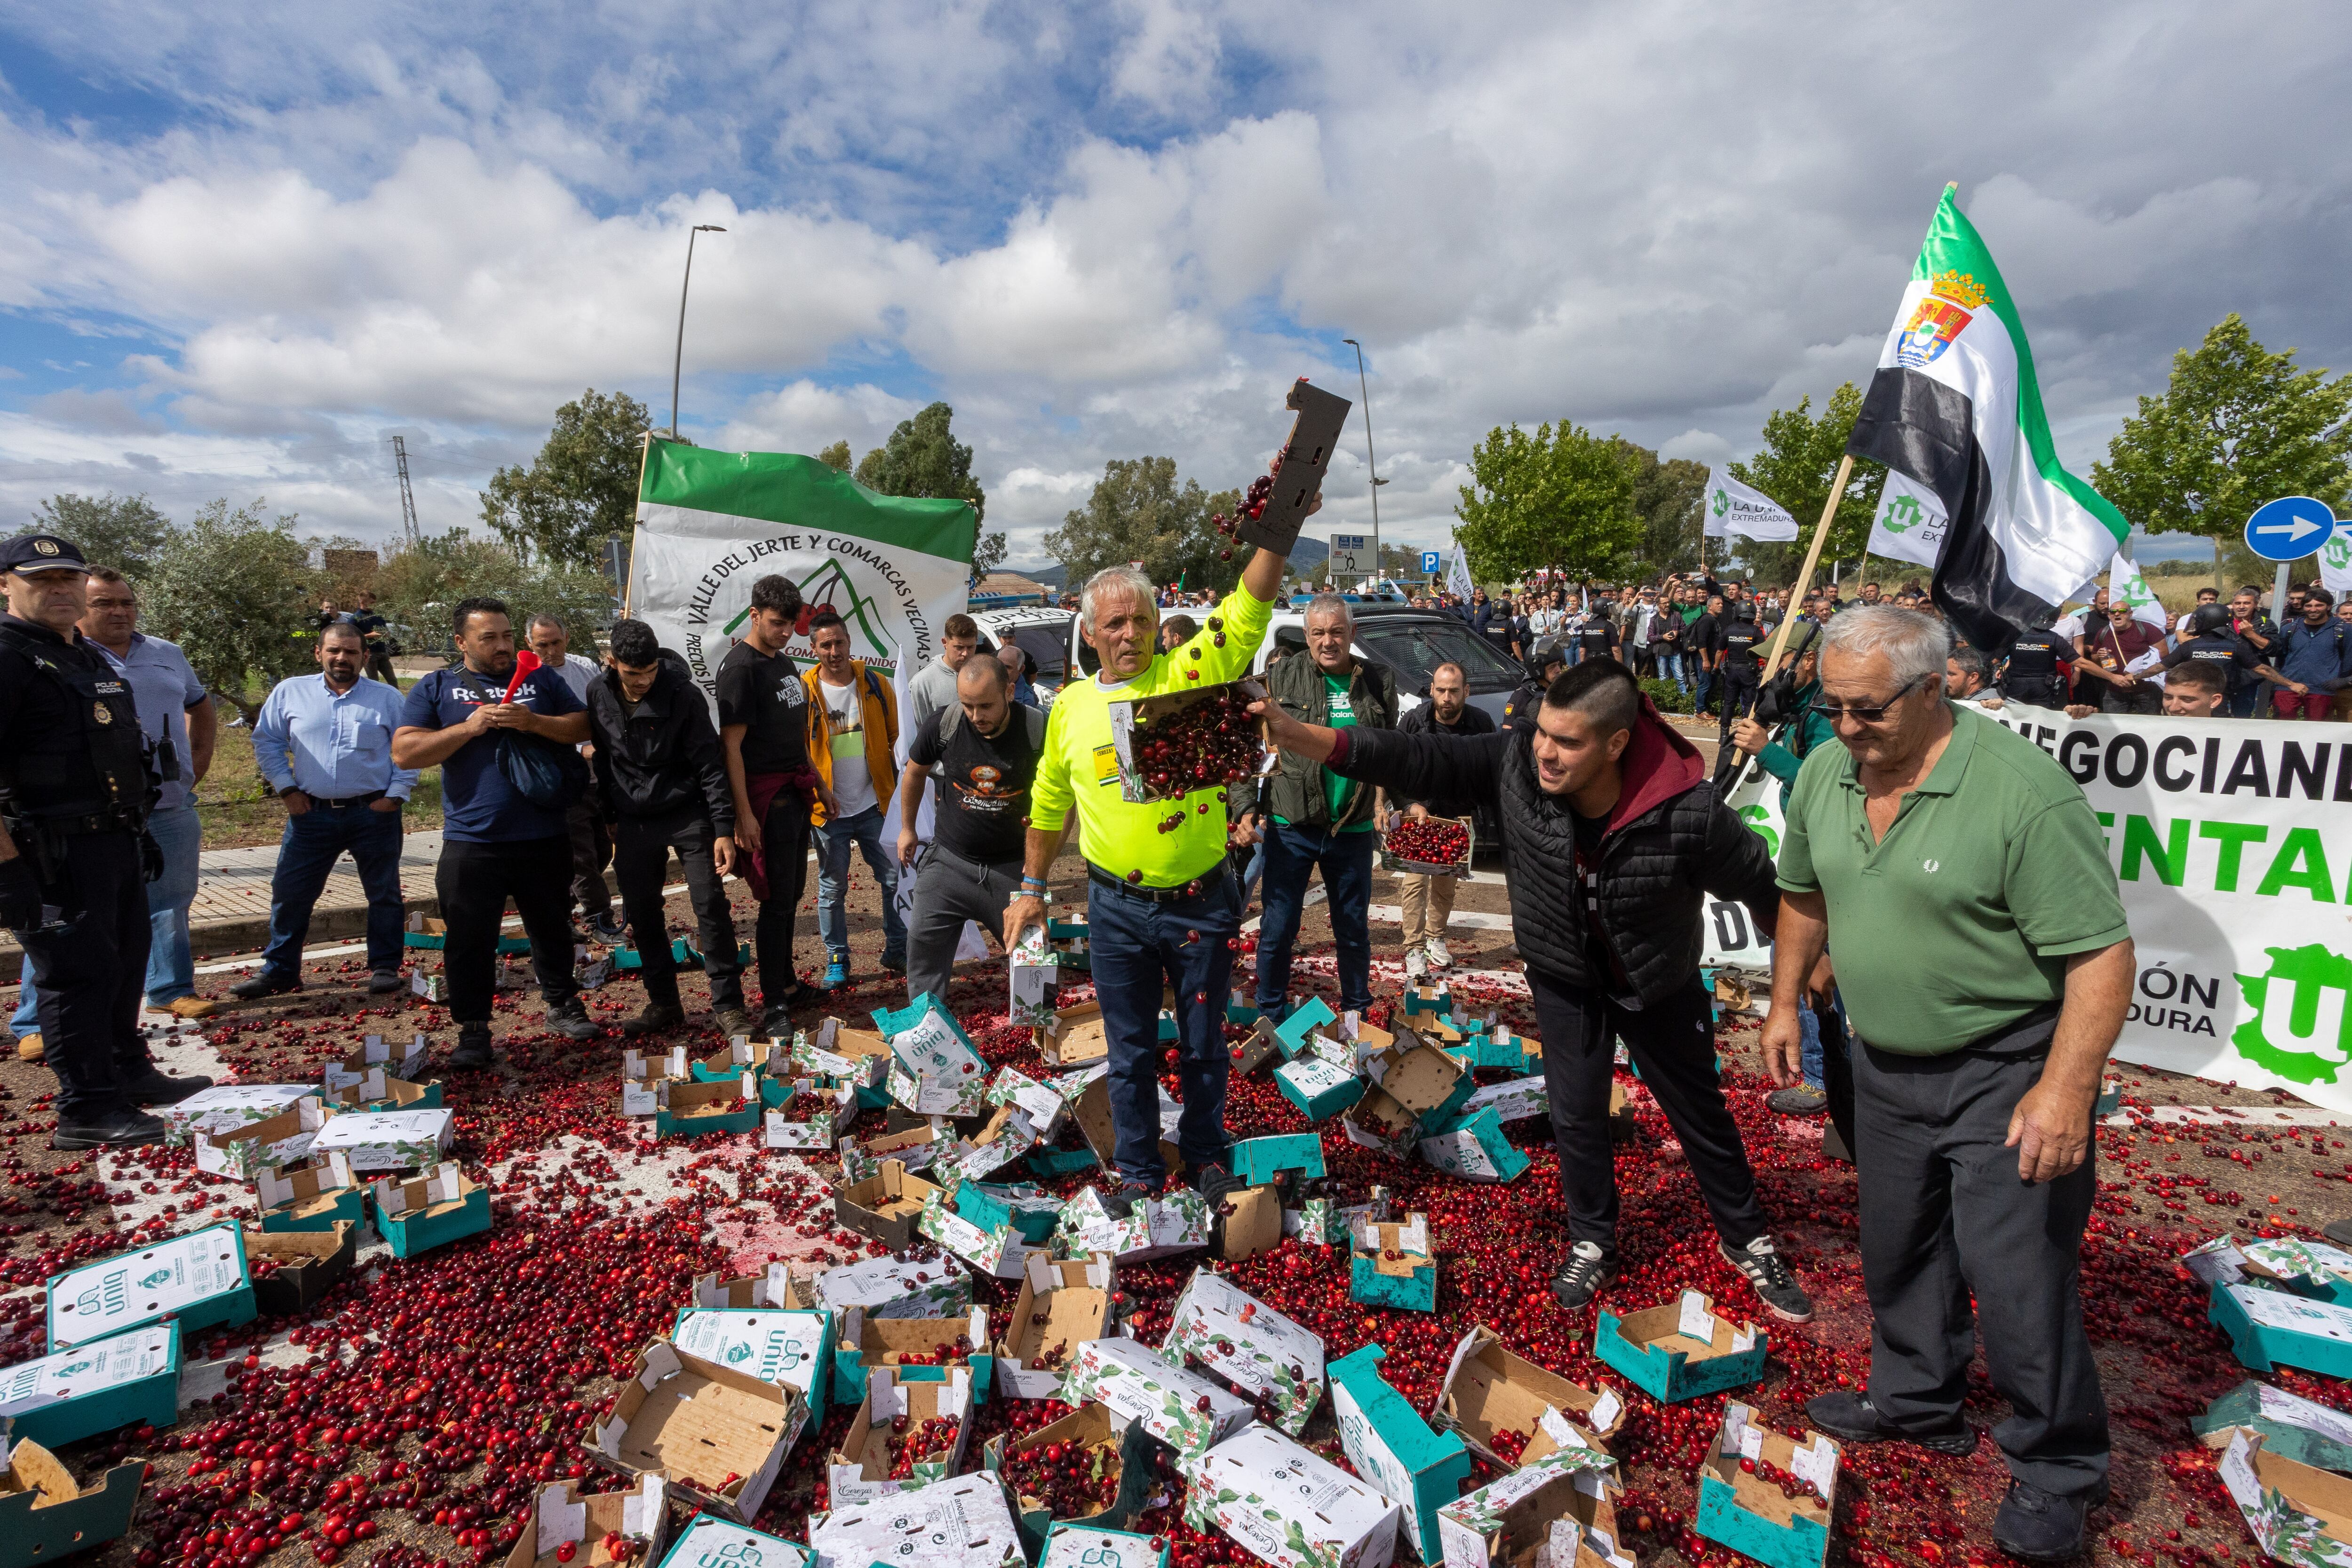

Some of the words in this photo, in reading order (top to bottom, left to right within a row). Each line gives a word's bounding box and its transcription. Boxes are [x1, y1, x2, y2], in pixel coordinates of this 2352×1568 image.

[1734, 501, 1750, 512] LA
[1922, 531, 1942, 543] EXT
[1425, 554, 1436, 571] P
[1455, 573, 1464, 585] LA
[688, 574, 721, 625] VALLE
[712, 553, 748, 578] DEL
[747, 535, 803, 563] JERTE
[808, 535, 822, 549] Y
[826, 537, 912, 597] COMARCAS
[903, 598, 931, 662] VECINAS
[686, 633, 710, 682] PRECIOS
[858, 655, 898, 669] UNIDO
[696, 679, 717, 701] JUS
[780, 677, 792, 687] THE
[777, 686, 798, 702] NORTH
[1097, 748, 1113, 756] CEREZAS
[1737, 804, 1780, 860] S
[2138, 961, 2220, 1010] ÓN
[2127, 1003, 2217, 1038] DURA
[820, 1053, 842, 1066] Cerezas
[771, 1123, 790, 1132] Cerezas
[286, 1131, 316, 1151] Cereza
[356, 1155, 391, 1169] Cerezas
[949, 1223, 972, 1240] Cerezas
[1089, 1230, 1115, 1245] Cerezas
[690, 1321, 702, 1348] RAMBLEÑOS
[1225, 1357, 1264, 1387] Cerezas
[1118, 1393, 1154, 1424] Cerezas
[1275, 1470, 1286, 1480] 23
[838, 1484, 872, 1497] Cerezas
[1507, 1472, 1545, 1495] Cerezas
[897, 1519, 907, 1528] 24
[1239, 1521, 1279, 1555] Cerezas
[902, 1544, 912, 1554] 23
